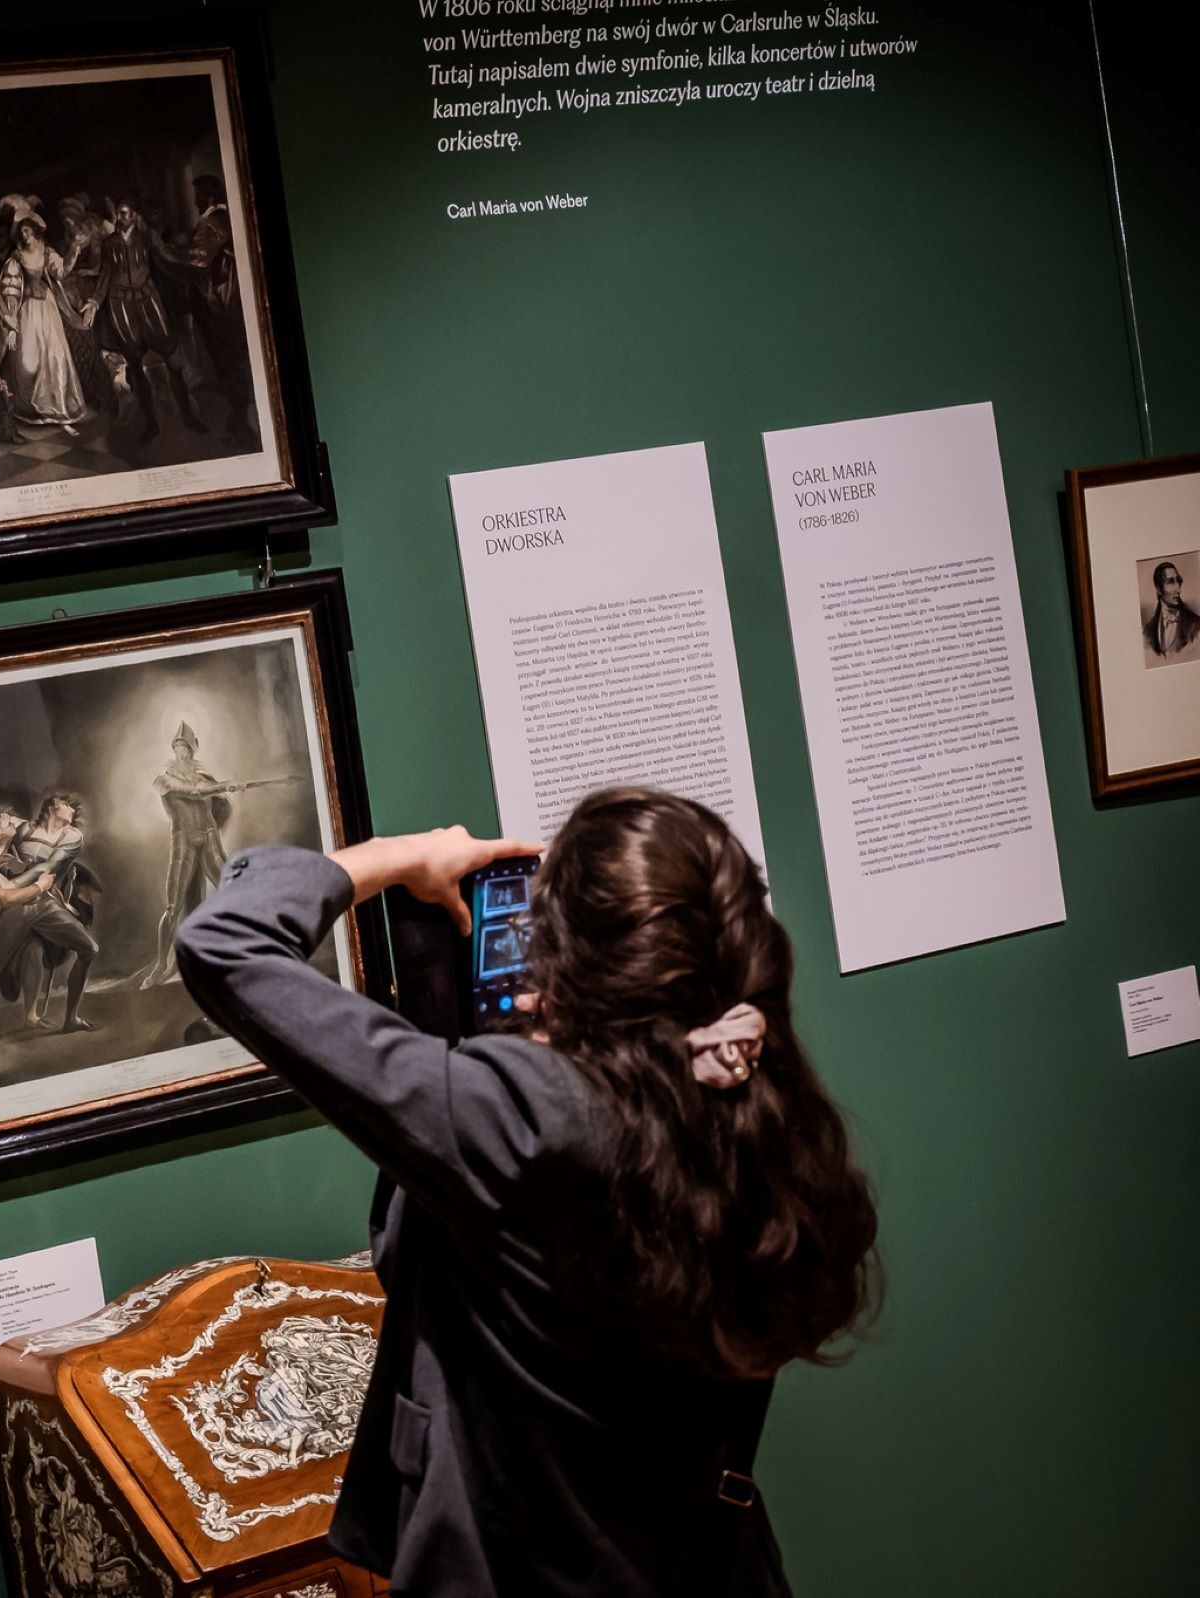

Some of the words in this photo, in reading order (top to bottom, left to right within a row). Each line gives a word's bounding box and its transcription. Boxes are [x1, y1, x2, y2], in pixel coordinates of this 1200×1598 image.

[419, 0, 438, 18] W
[443, 0, 491, 17] 1806
[497, 0, 536, 14] roku
[423, 36, 455, 52] von
[461, 24, 582, 49] Württemberg
[586, 27, 608, 42] na
[613, 18, 650, 44] swój
[656, 16, 698, 37] dwór
[702, 21, 716, 34] w
[720, 10, 803, 34] Carlsruhe
[807, 15, 821, 28] w
[824, 2, 879, 31] Śląsku.
[428, 63, 473, 89] Tutaj
[479, 57, 569, 86] napisałem
[575, 54, 616, 75] dwie
[621, 49, 703, 78] symfonie,
[708, 45, 746, 66] kilka
[751, 40, 836, 63] koncertów
[840, 39, 845, 57] i
[850, 35, 918, 57] utworów
[433, 90, 551, 119] kameralnych.
[556, 88, 611, 113] Wojna
[615, 80, 701, 107] zniszczyła
[706, 82, 762, 101] uroczy
[765, 75, 806, 94] teatr
[809, 72, 813, 91] i
[818, 69, 875, 92] dzielną
[437, 130, 522, 152] orkiestrę.
[447, 201, 476, 219] Carl
[479, 200, 518, 216] Maria
[520, 200, 544, 212] von
[545, 193, 588, 210] Weber
[792, 467, 830, 487] CARL
[832, 461, 877, 481] MARIA
[794, 489, 827, 508] VON
[828, 482, 877, 503] WEBER
[482, 506, 567, 532] ORKIESTRA
[798, 509, 860, 531] (1786-1826)
[485, 529, 565, 555] DWORSKA
